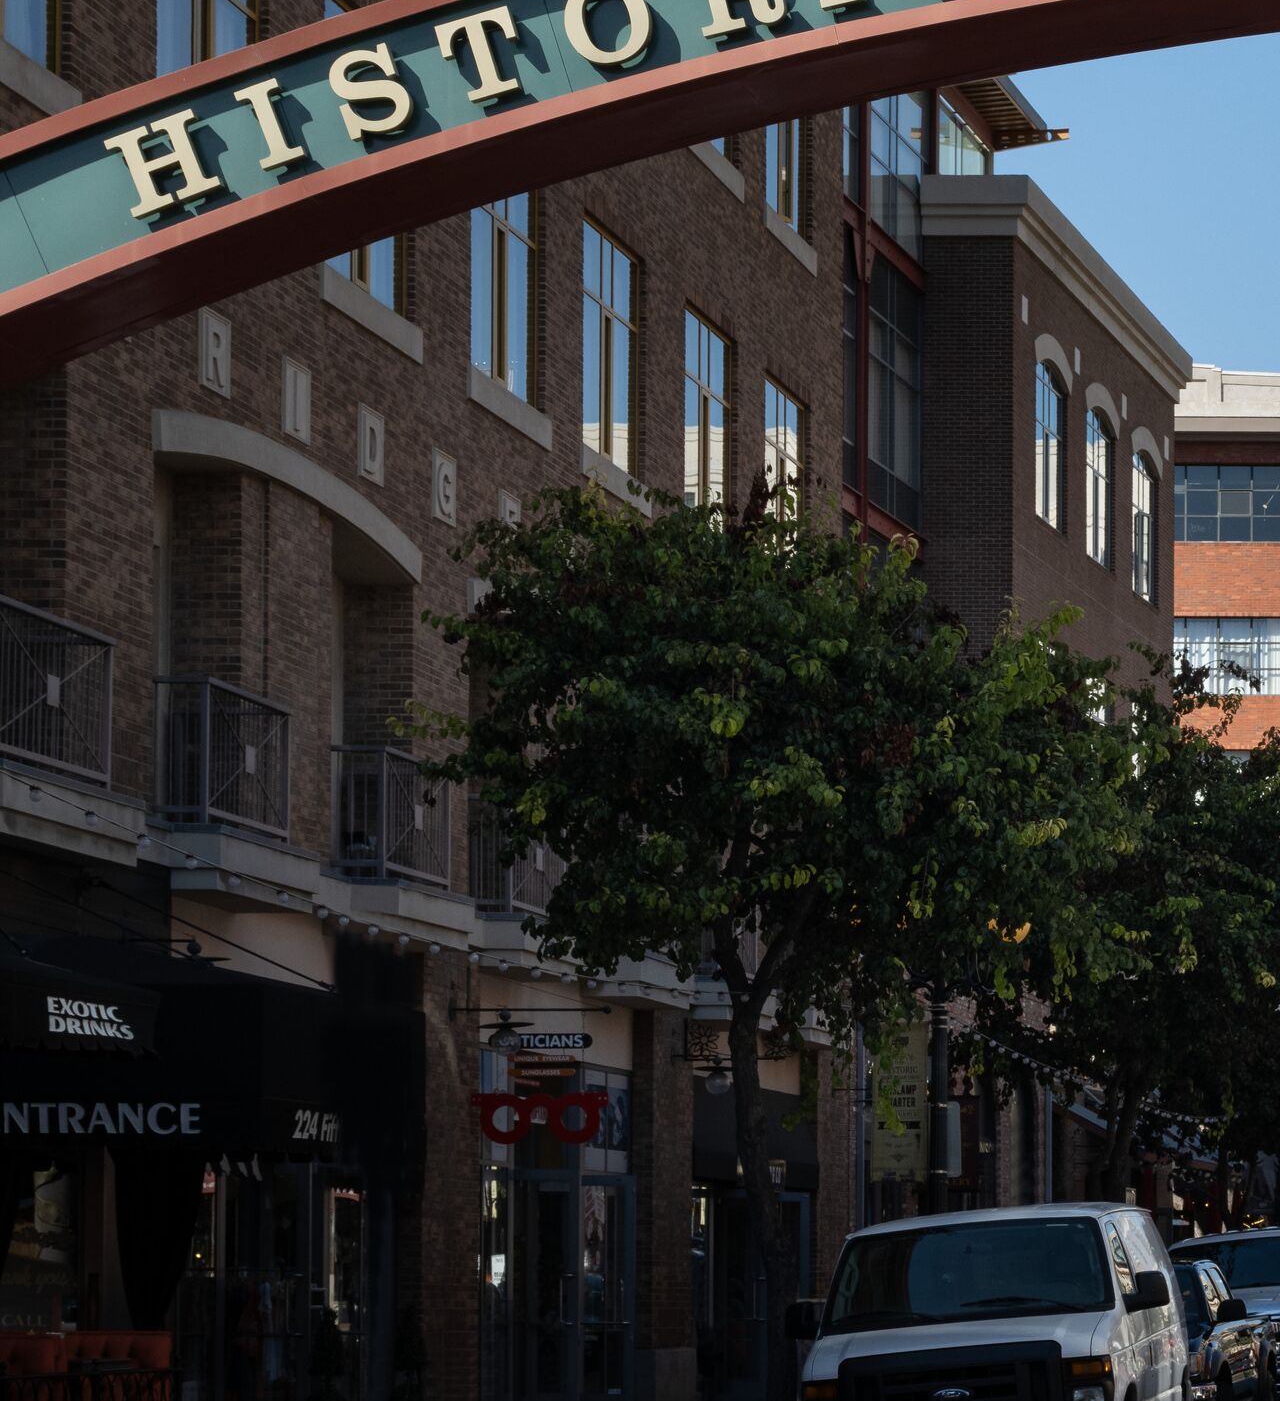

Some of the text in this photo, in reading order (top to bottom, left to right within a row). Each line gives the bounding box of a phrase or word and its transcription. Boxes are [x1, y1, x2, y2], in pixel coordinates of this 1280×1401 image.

[46, 995, 123, 1023] EXOTIC
[48, 1014, 135, 1041] DRINKS
[0, 1101, 202, 1135] NTRANCE
[291, 1109, 320, 1141] 224
